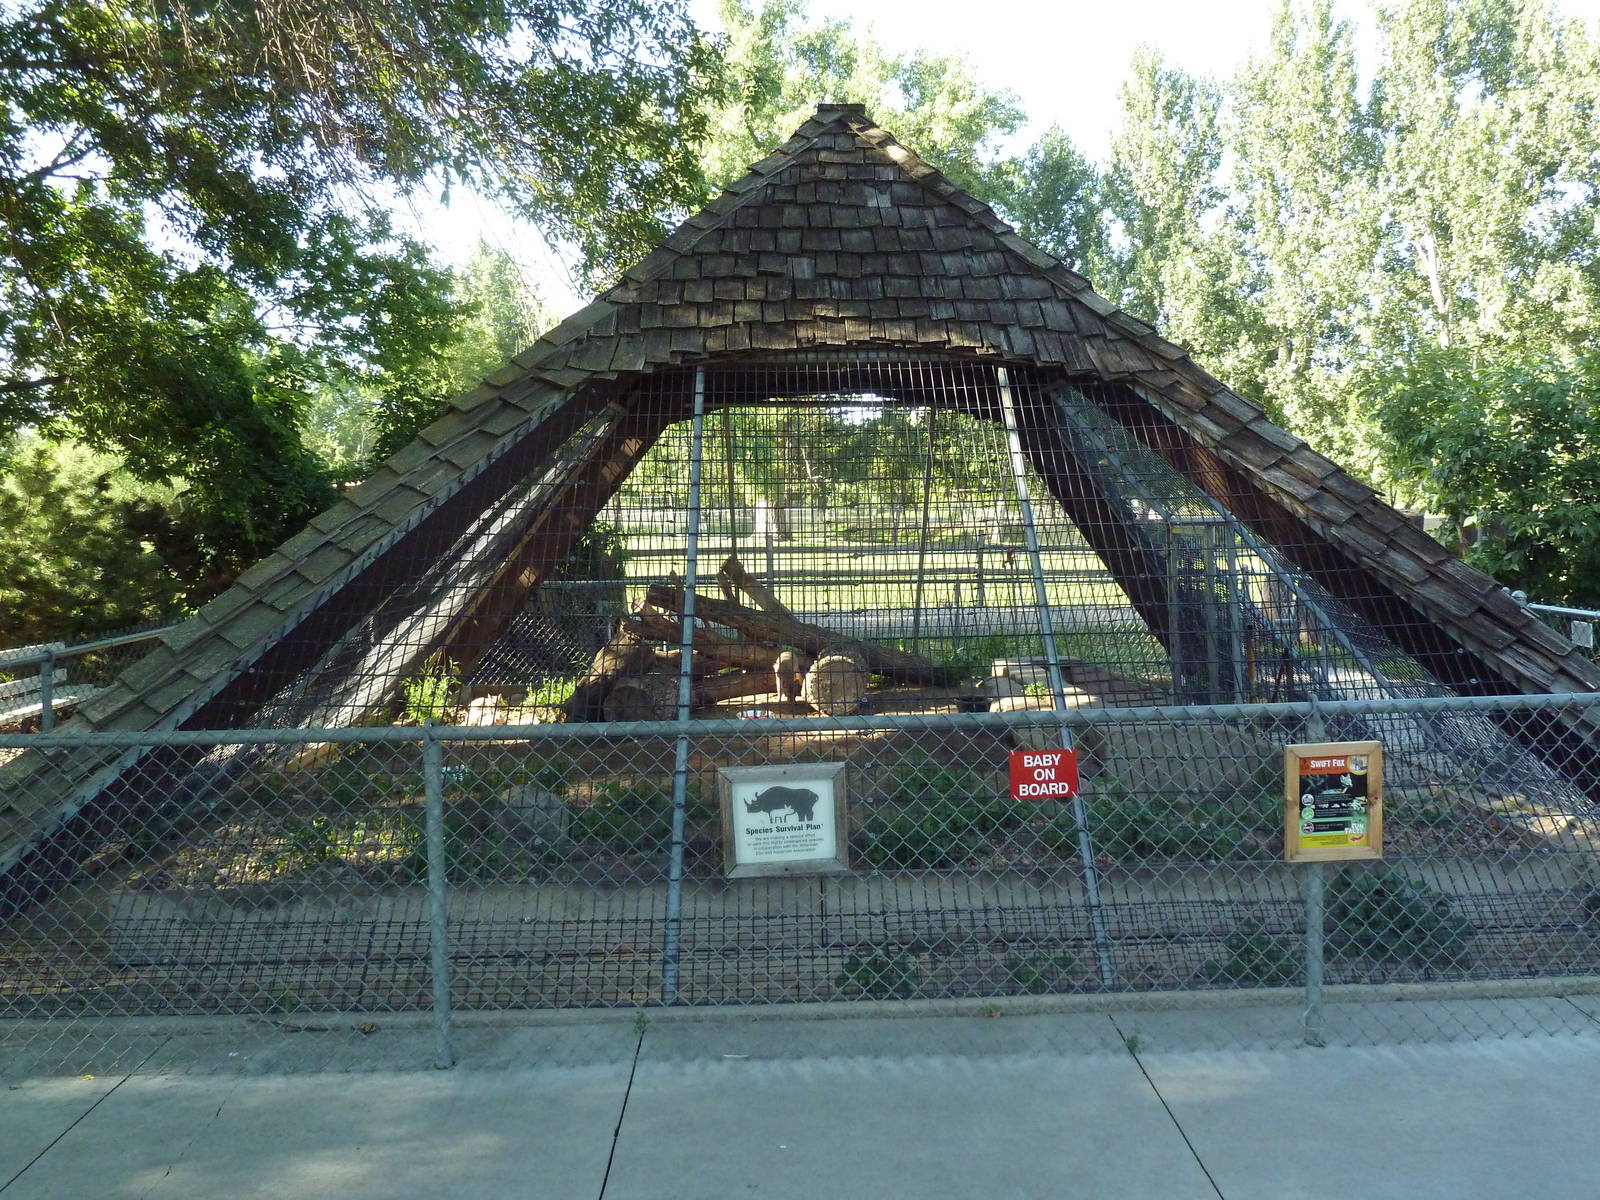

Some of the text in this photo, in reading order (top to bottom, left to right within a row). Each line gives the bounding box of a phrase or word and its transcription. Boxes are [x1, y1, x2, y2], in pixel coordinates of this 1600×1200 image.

[1023, 753, 1062, 767] BABY
[1311, 759, 1345, 768] SWIFT FOX
[1033, 768, 1055, 781] ON
[1019, 782, 1069, 796] BOARD
[745, 827, 773, 835] Species
[776, 824, 803, 832] Survival
